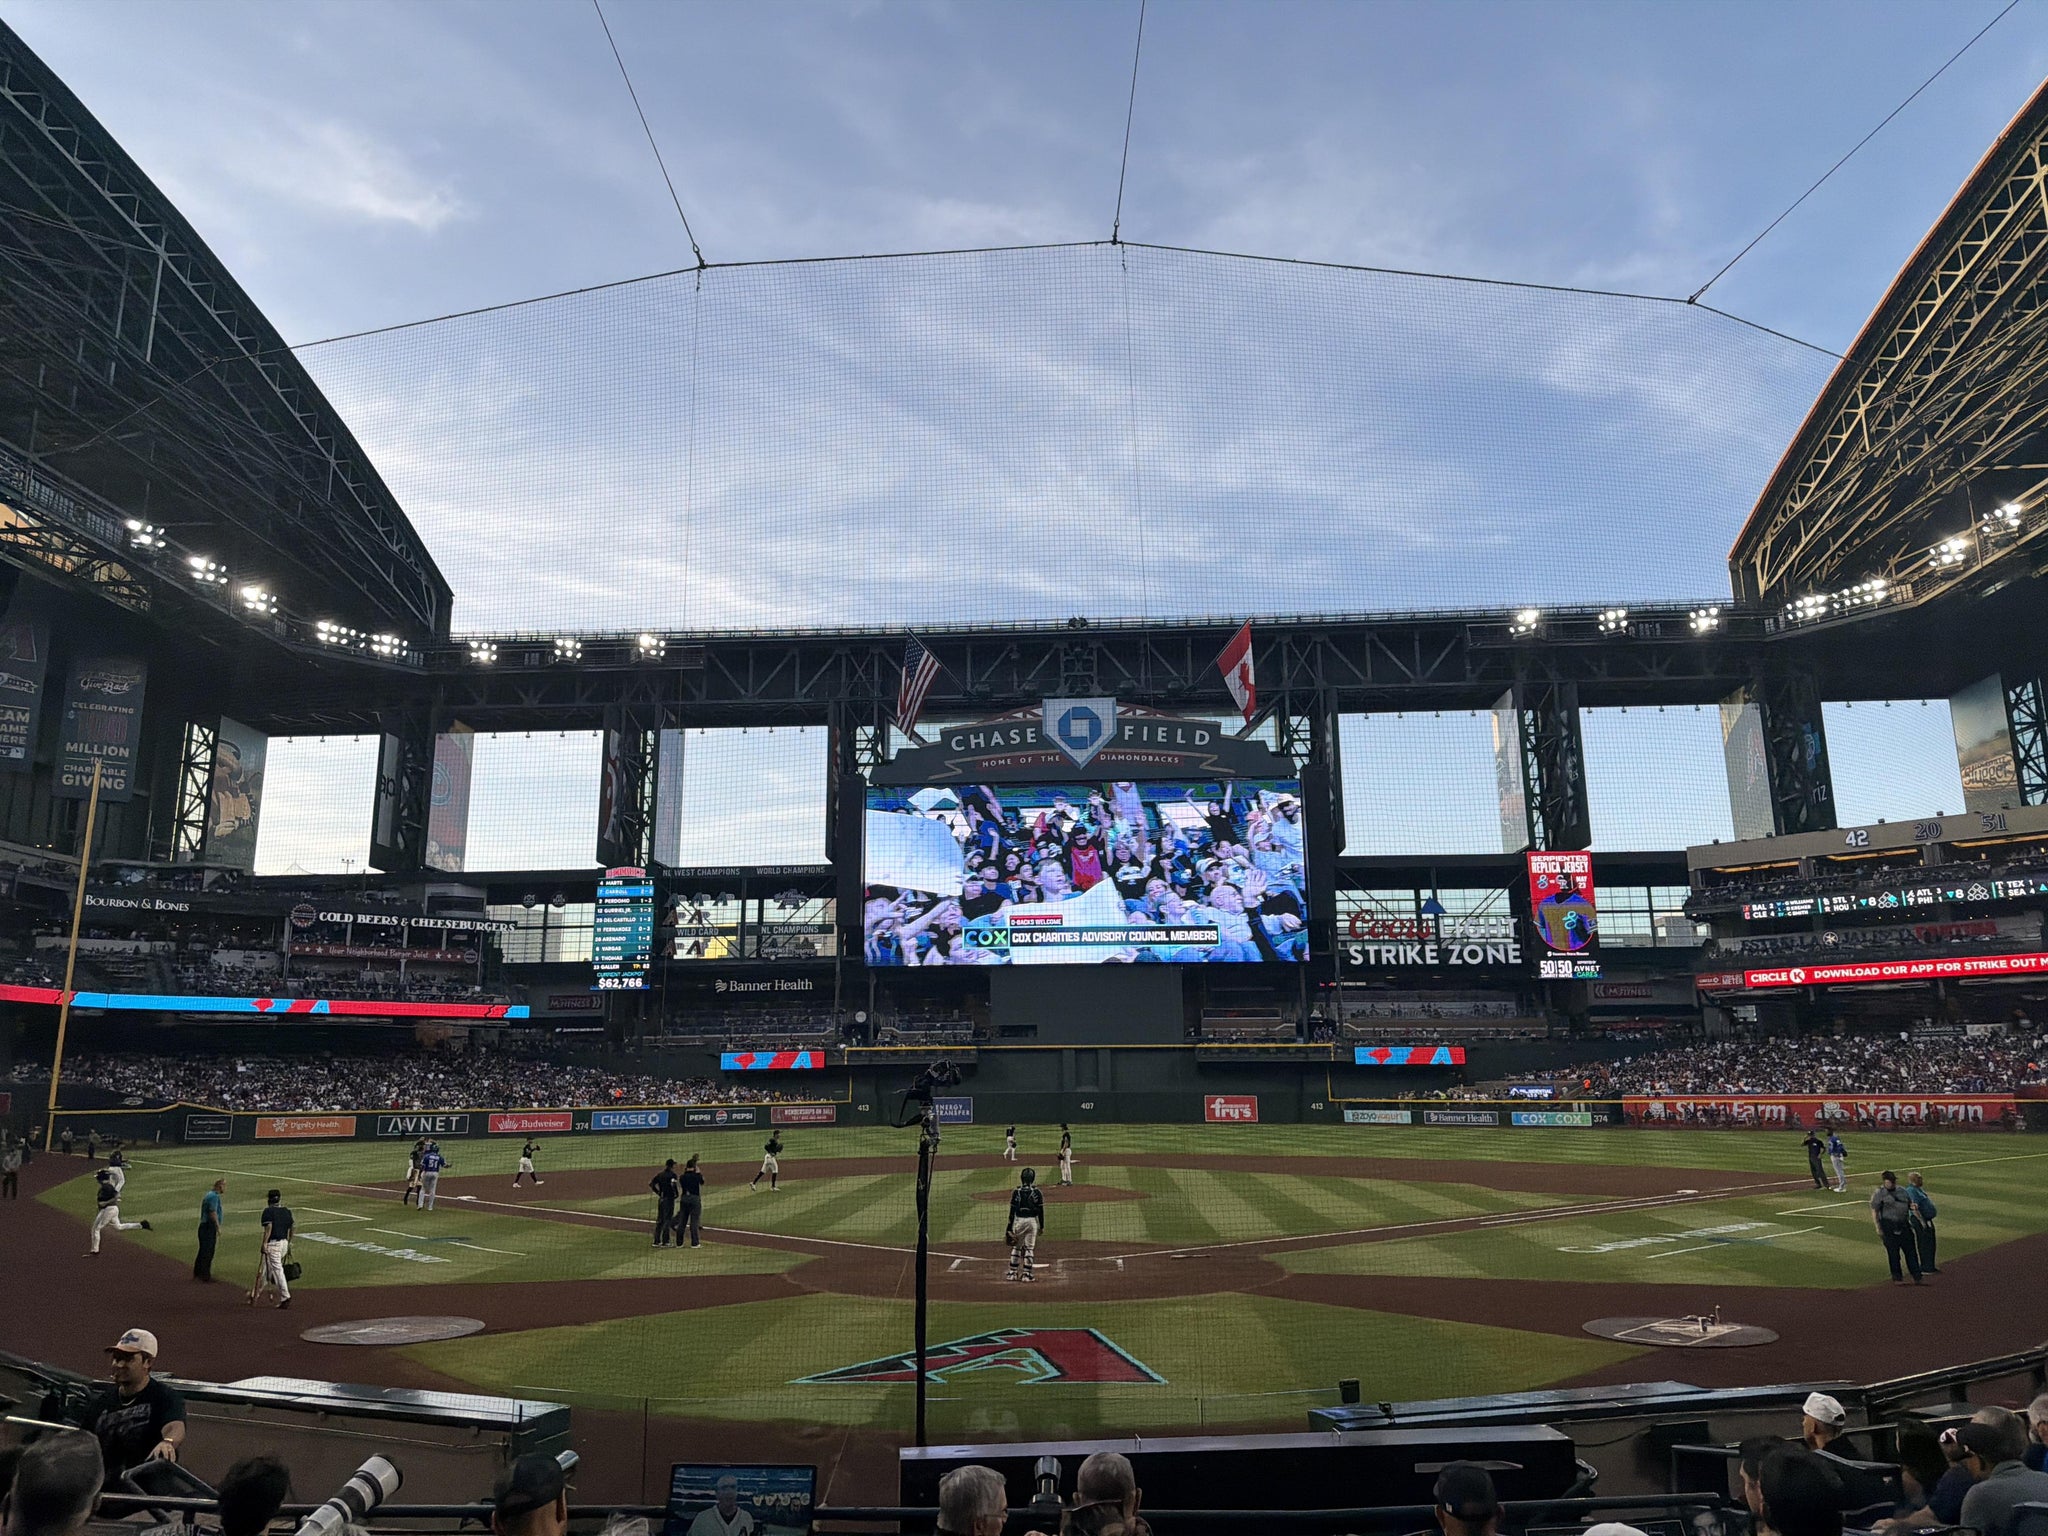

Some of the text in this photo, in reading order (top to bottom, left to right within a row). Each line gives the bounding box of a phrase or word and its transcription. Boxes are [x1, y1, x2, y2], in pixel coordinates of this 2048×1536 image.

[72, 701, 134, 714] CELEBRATING
[951, 725, 1211, 751] CHASE FIELD
[65, 742, 130, 758] MILLION
[982, 754, 1180, 767] HOME OF THE DIAMONDBACKS
[63, 764, 127, 777] CHARIABLE
[62, 774, 126, 789] GIVNG
[1981, 813, 2008, 833] 51
[1913, 820, 1942, 841] 20
[1845, 829, 1870, 847] 42
[662, 868, 741, 877] NL WEST CHAMPIONS
[756, 866, 826, 875] WORLD CHAMPIONS
[1531, 861, 1588, 873] REPLICA JERSEY
[2007, 880, 2025, 888] TEX
[1916, 889, 1933, 897] ATL
[1955, 889, 1964, 898] 8
[2008, 888, 2027, 896] SEA
[141, 898, 152, 909] &
[1868, 897, 1877, 906] 8
[1918, 896, 1933, 904] PHI
[1751, 904, 1767, 912] BAL
[1833, 904, 1849, 912] HOU
[1752, 911, 1767, 919] CLE
[319, 911, 353, 923] COLD
[357, 912, 399, 926] BEERS
[400, 917, 409, 927] &
[411, 917, 516, 932] CHEESEBURGERS
[1035, 918, 1061, 926] WELCOME
[1346, 909, 1518, 940] Coors LIGHT
[761, 925, 819, 934] NL CHAMPIONS
[965, 929, 1007, 946] COX
[1012, 930, 1218, 943] COX CHARITIES ADVISORY COUNCIL MEMBERS
[346, 947, 388, 957] Neighborhood
[1349, 943, 1522, 965] STRIKE ZONE
[1750, 971, 1788, 983] CIRCLE
[1792, 969, 1804, 982] K
[1814, 967, 1880, 979] DOWNLOAD
[1883, 965, 1908, 976] OUR
[1911, 963, 1933, 974] APP
[1936, 961, 1961, 972] FOR
[1964, 958, 2008, 970] STRIKE
[2010, 957, 2037, 968] OUT
[598, 977, 643, 989] $62,766
[729, 978, 813, 992] Banner Health
[1080, 1102, 1094, 1110] 407
[1210, 1098, 1253, 1119] fry's
[1310, 1102, 1324, 1110] 413
[601, 1114, 646, 1126] CHASE
[1438, 1113, 1493, 1122] Banner Health
[1521, 1114, 1582, 1124] COX COX
[1593, 1115, 1608, 1123] 374
[290, 1121, 315, 1131] Dignity
[388, 1117, 459, 1132] AVNET
[521, 1119, 564, 1128] Budweiser
[575, 1122, 589, 1130] 374
